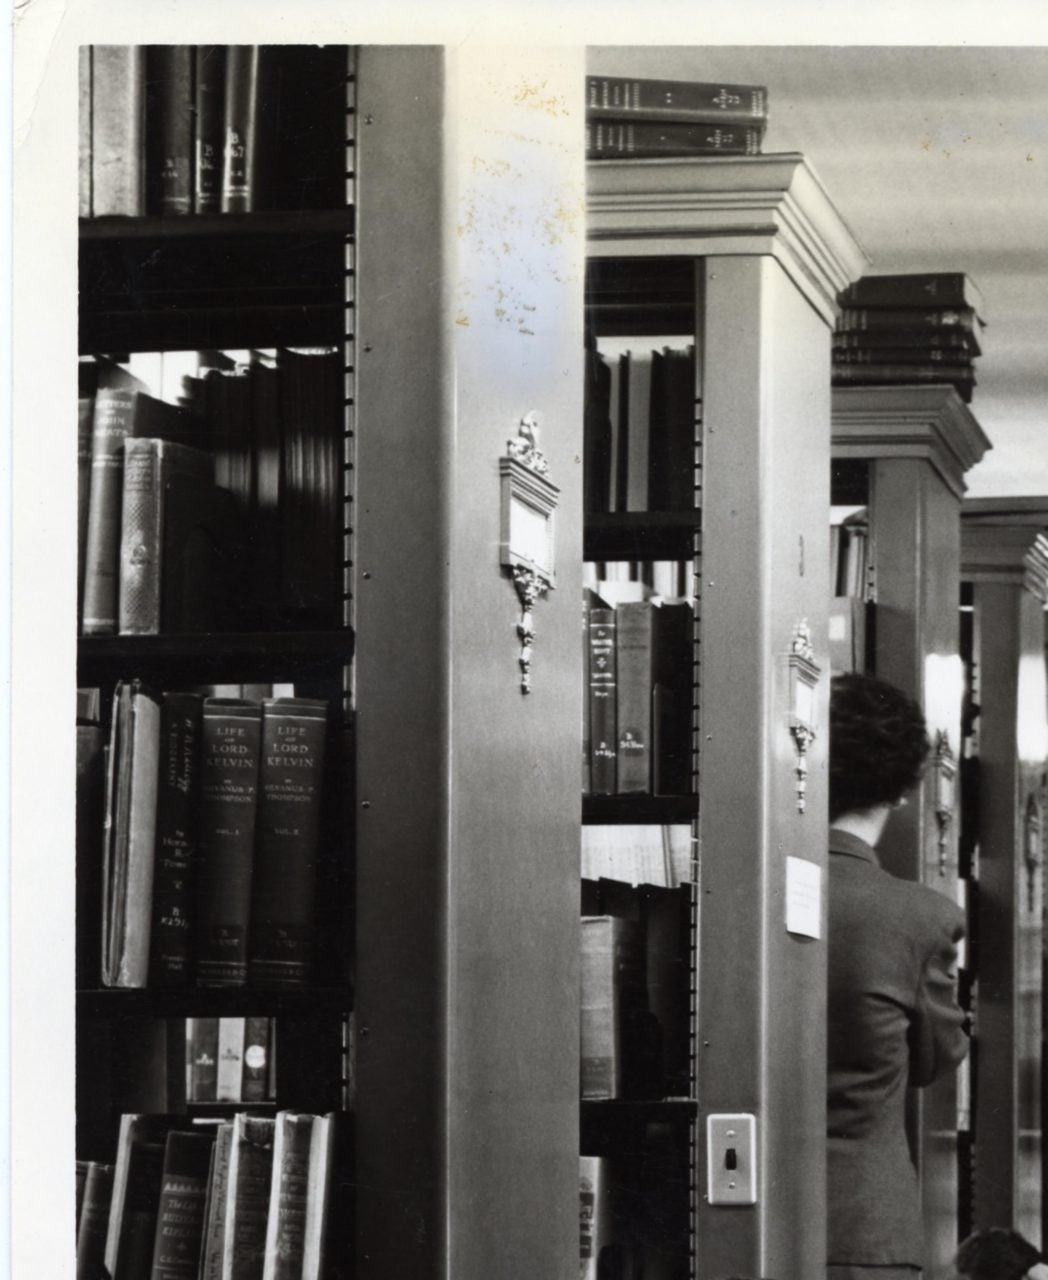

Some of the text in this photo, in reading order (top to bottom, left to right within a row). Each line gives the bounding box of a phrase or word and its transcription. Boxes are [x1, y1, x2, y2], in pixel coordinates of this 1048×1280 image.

[217, 727, 245, 737] LIFE
[277, 726, 306, 736] LIFE
[212, 743, 248, 754] LORD
[273, 743, 309, 754] LORD
[206, 757, 254, 768] KELVIN
[266, 757, 314, 768] KELVIN
